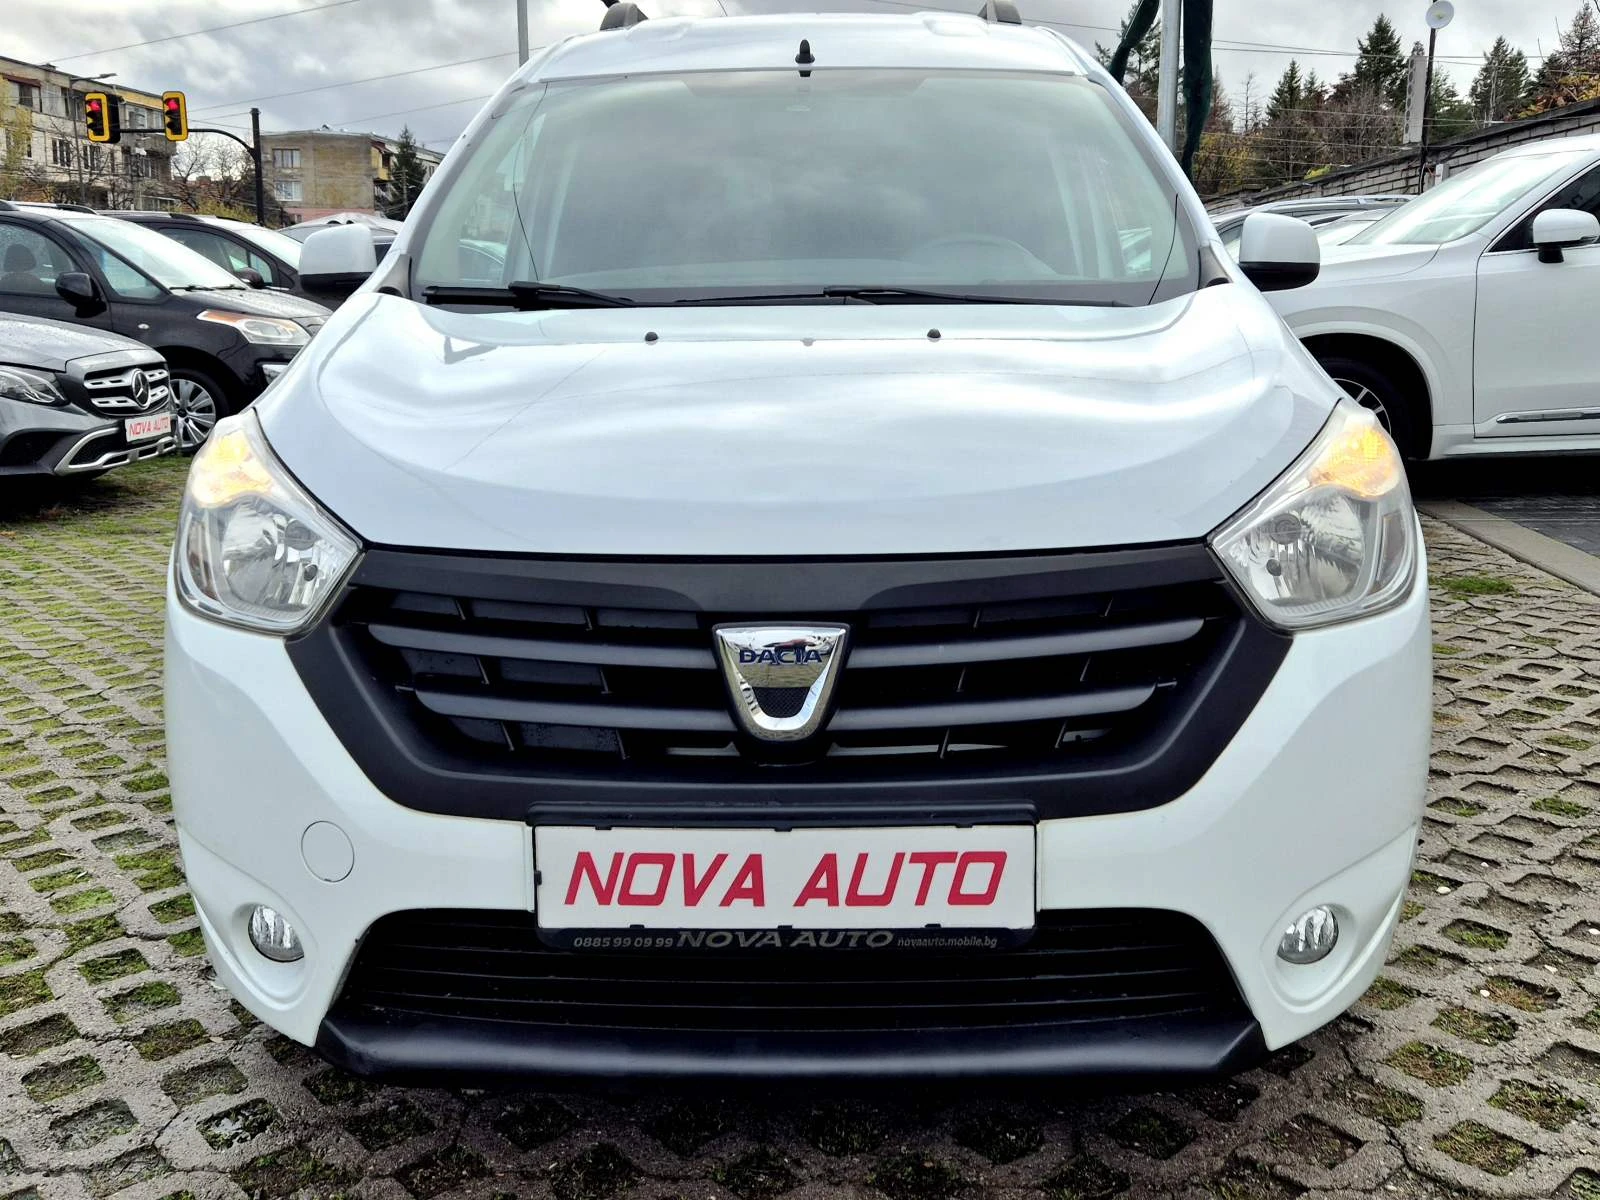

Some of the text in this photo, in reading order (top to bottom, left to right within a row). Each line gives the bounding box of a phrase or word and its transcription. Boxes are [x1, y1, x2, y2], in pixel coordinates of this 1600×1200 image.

[129, 421, 151, 436] NOVA
[739, 649, 822, 664] DACIA
[564, 851, 1007, 907] NOVA AUTO
[573, 931, 998, 948] 0885 99 09 99 NOVA AUTO novaauto.mobile.bg
